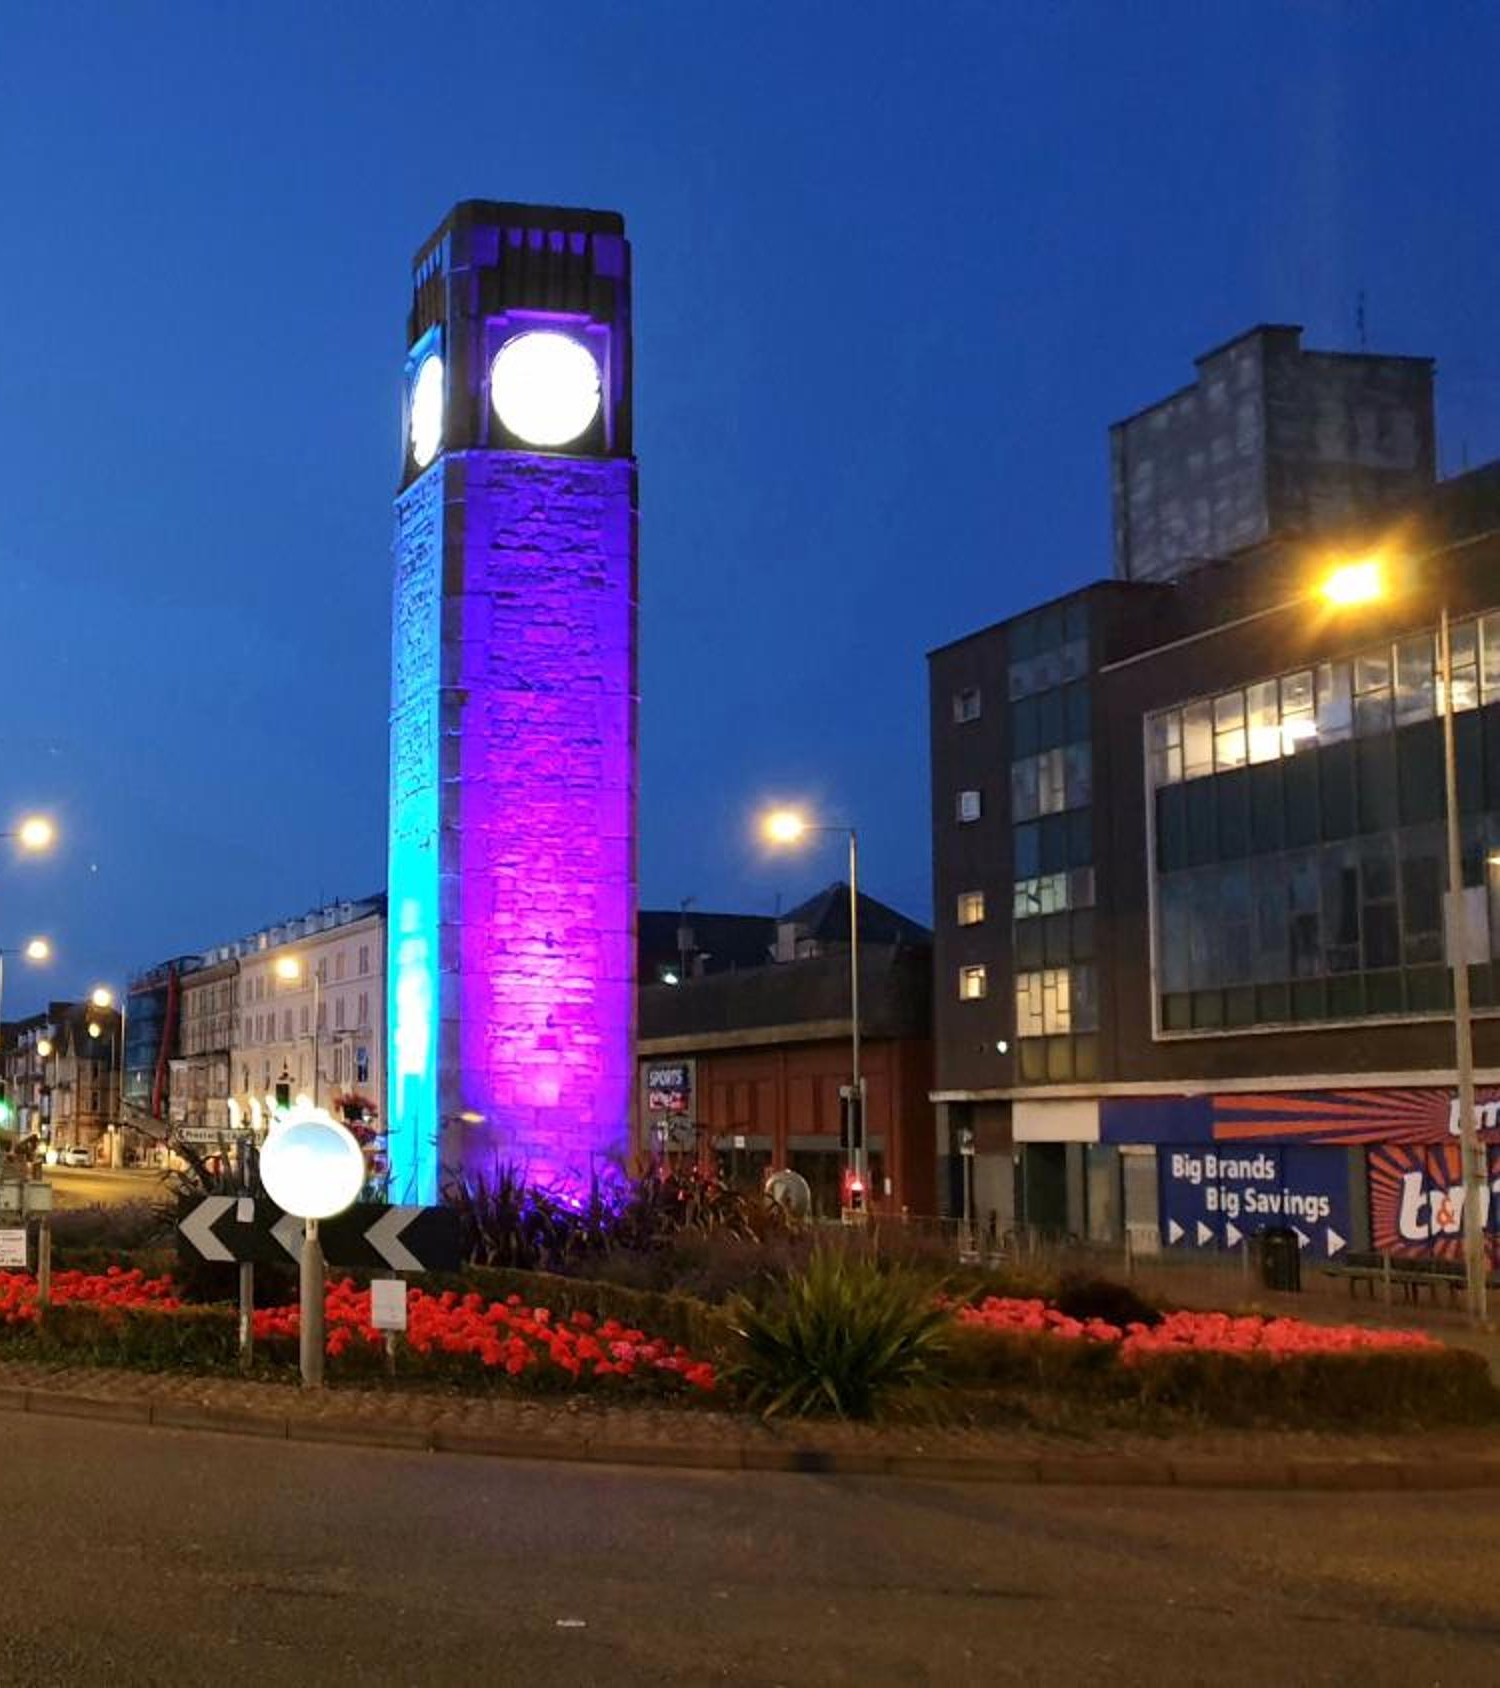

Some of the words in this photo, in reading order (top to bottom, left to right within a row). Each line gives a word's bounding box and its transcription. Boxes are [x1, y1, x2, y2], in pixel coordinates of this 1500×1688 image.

[650, 1070, 683, 1087] SPORTS
[1171, 1153, 1201, 1184] Big
[1204, 1153, 1276, 1180] Brands
[1205, 1186, 1240, 1218] Big
[1244, 1187, 1331, 1223] Savings
